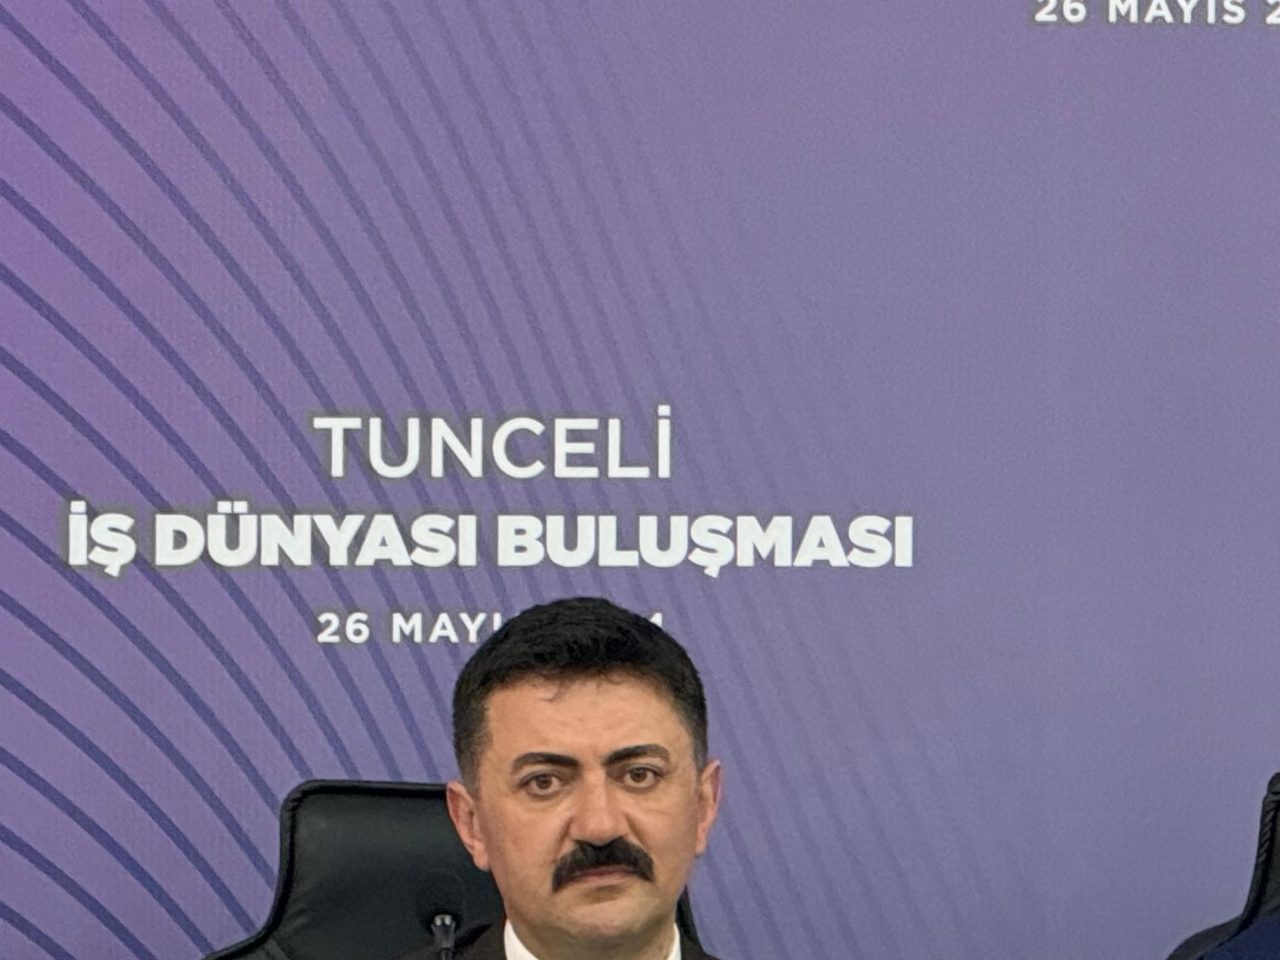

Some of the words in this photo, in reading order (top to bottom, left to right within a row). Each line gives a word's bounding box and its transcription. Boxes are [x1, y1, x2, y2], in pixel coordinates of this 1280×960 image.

[1035, 0, 1086, 23] 26
[1108, 0, 1246, 24] MAYIS
[312, 404, 671, 480] TUNCELİ
[68, 500, 137, 578] İŞ
[155, 500, 477, 568] DÜNYASI
[497, 513, 914, 579] BULUŞMASI
[316, 612, 370, 644] 26
